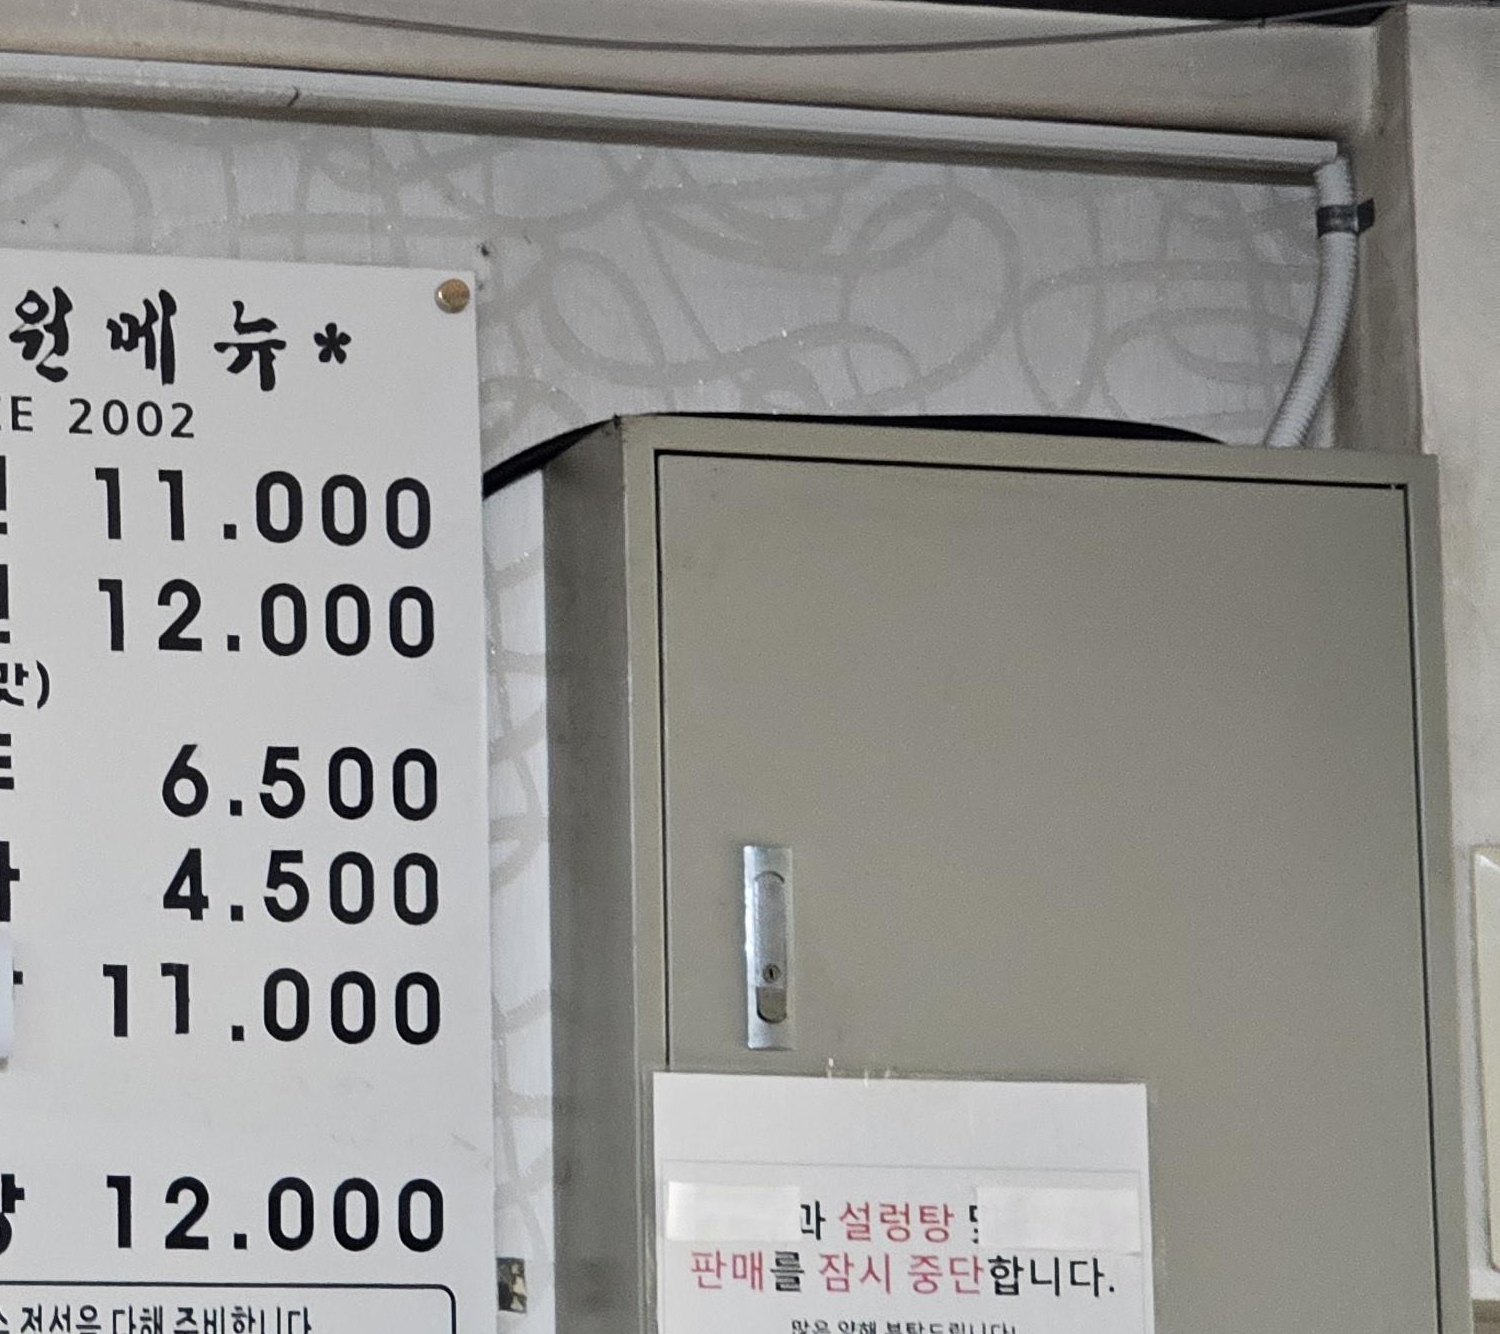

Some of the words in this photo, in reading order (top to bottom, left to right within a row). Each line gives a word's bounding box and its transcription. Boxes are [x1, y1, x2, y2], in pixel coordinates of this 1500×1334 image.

[69, 398, 194, 438] 2002
[95, 467, 430, 549] 11.000
[98, 579, 434, 658] 12.000
[162, 744, 437, 821] 6.500
[163, 848, 438, 925] 4.500
[103, 963, 440, 1045] 11.000
[107, 1175, 443, 1252] 12.000
[839, 1202, 954, 1243] 설렁탕
[692, 1251, 805, 1292] 판매를
[819, 1252, 890, 1294] 잠시
[909, 1255, 1114, 1297] 중단합니다.
